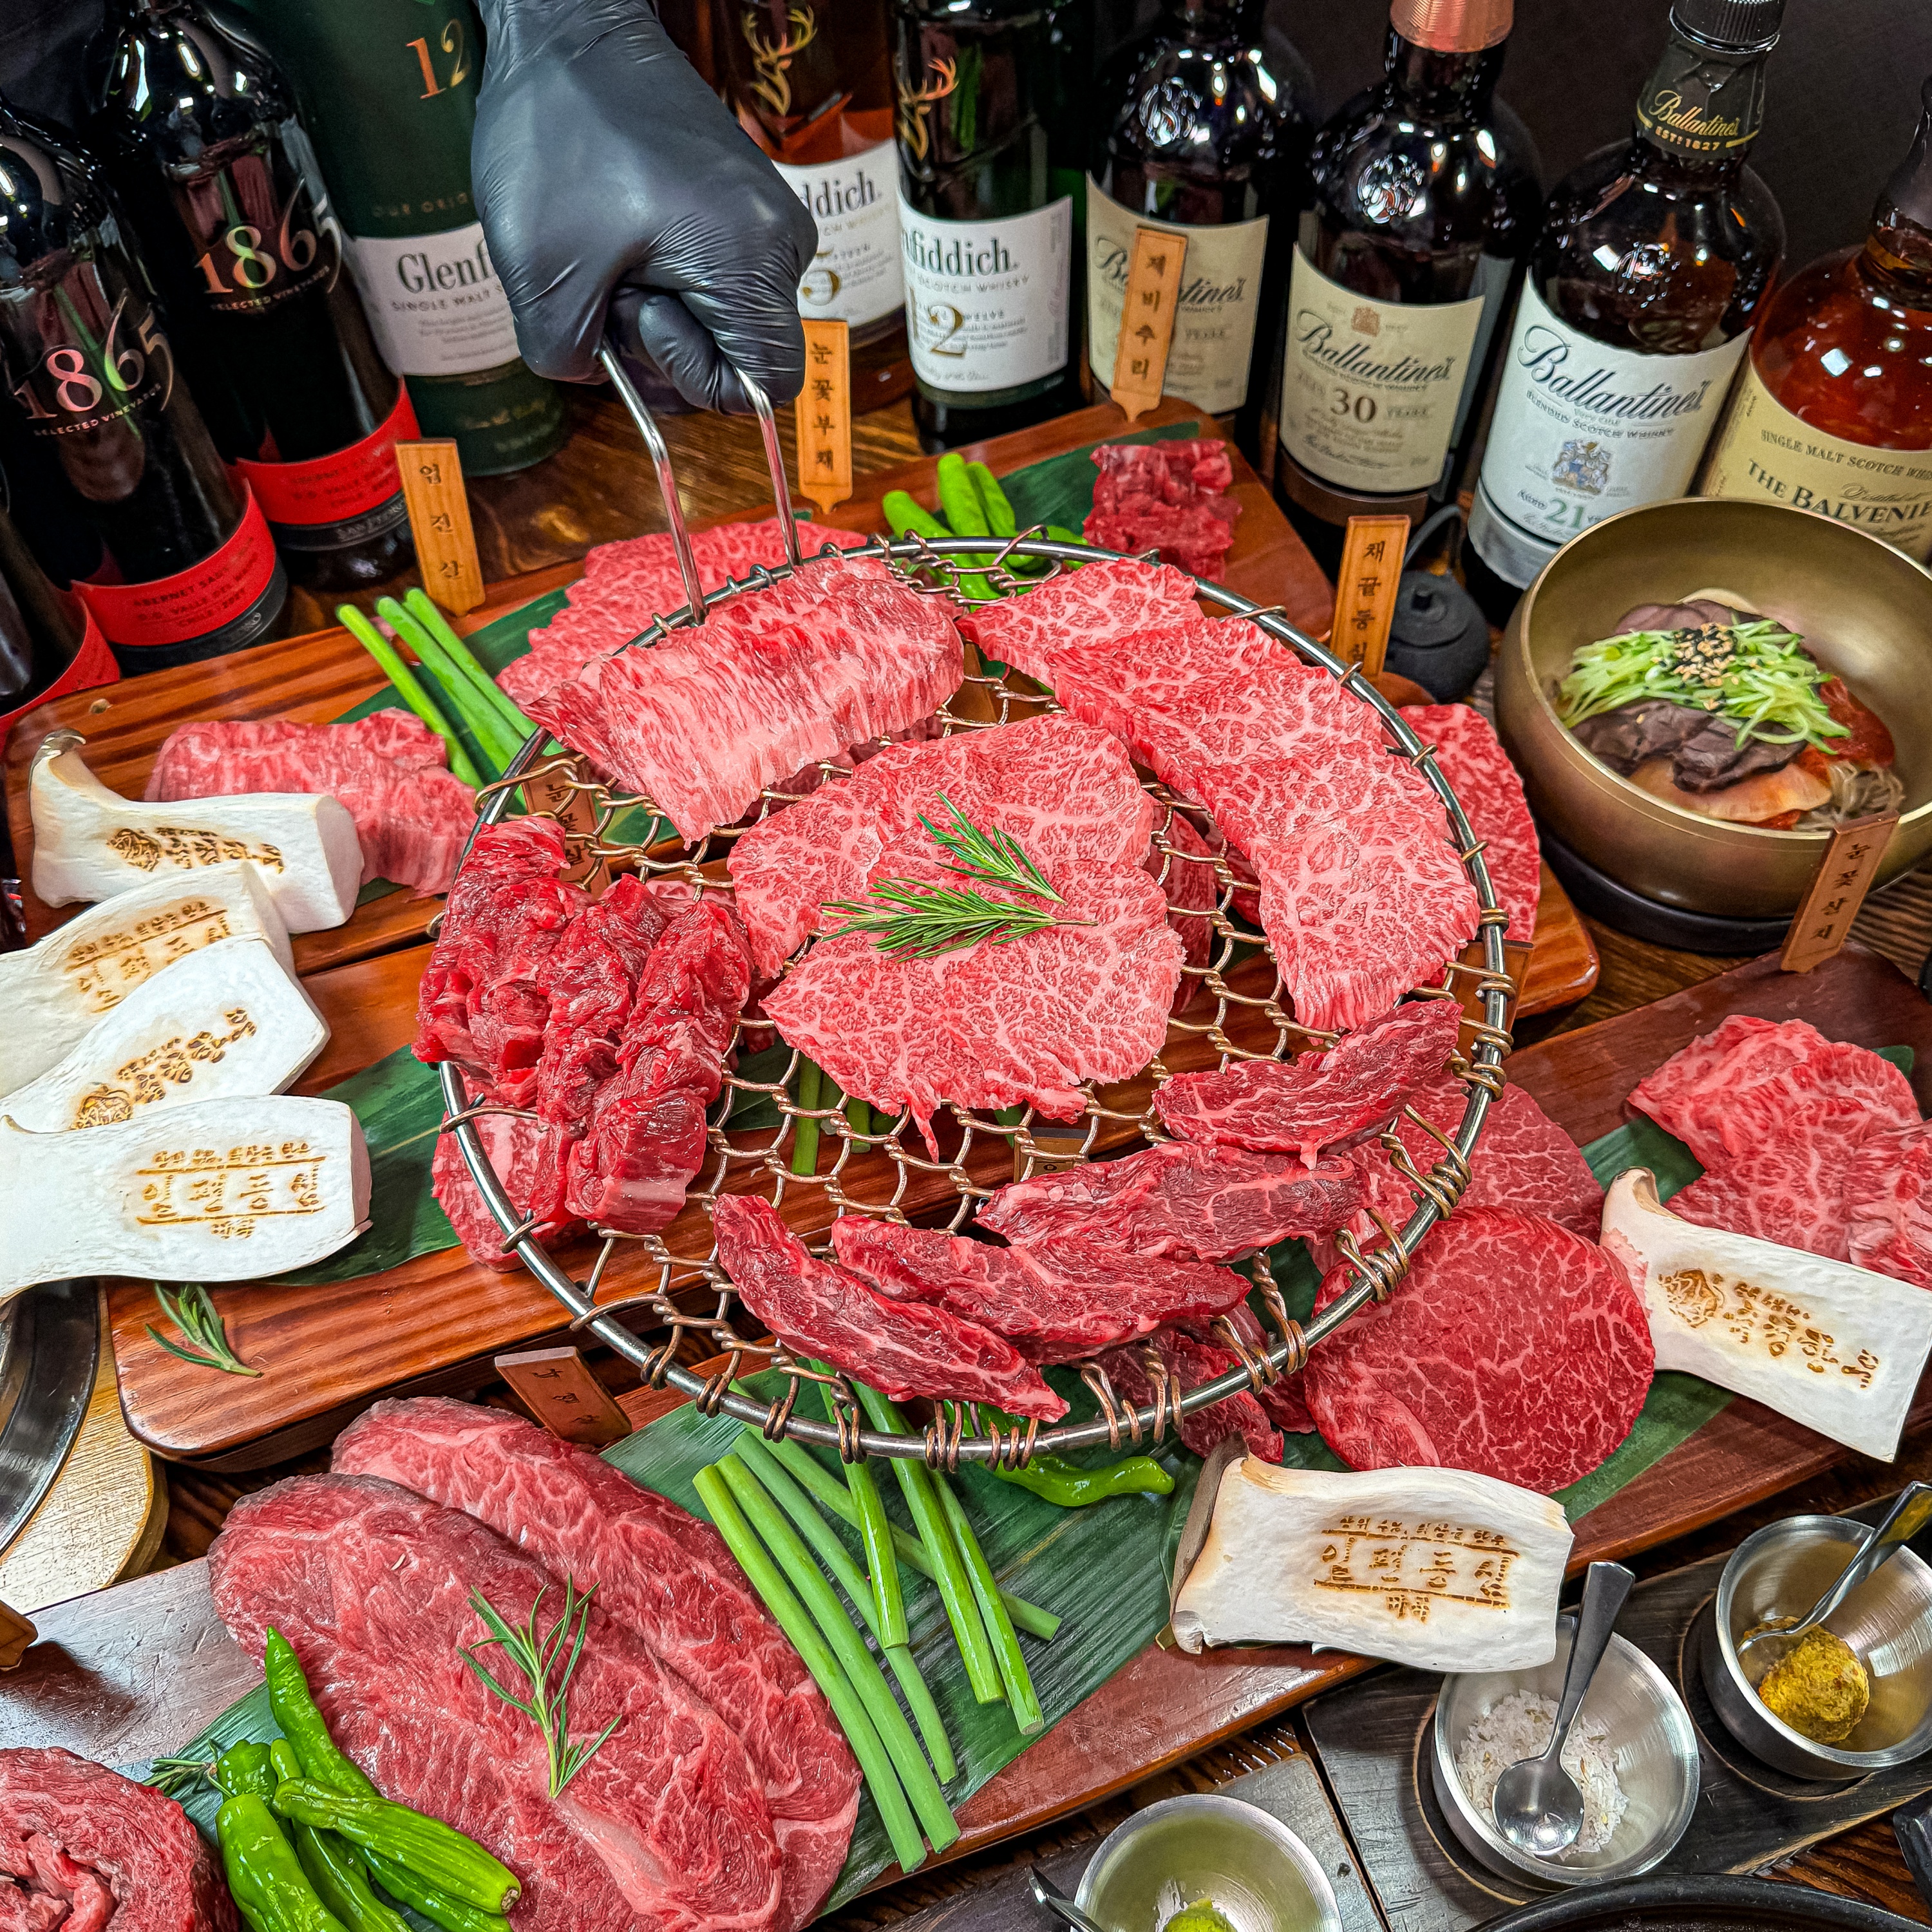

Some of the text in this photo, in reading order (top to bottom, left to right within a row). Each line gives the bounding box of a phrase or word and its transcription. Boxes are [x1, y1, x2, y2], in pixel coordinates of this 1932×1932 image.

[406, 19, 471, 99] 12
[1649, 90, 1741, 137] Ballantine's
[1685, 137, 1721, 151] 1827
[194, 177, 342, 294] 1865
[396, 238, 495, 294] Glenf
[14, 290, 173, 420] 1865
[1296, 310, 1455, 384] Ballantine's
[1517, 324, 1714, 419] Ballantine's
[1330, 388, 1378, 424] 30
[1761, 429, 1803, 453] SINGLE
[1805, 444, 1845, 464] MALT
[1847, 455, 1904, 476] SCOTCH
[1748, 459, 1788, 498] THE
[1544, 498, 1585, 529] 21
